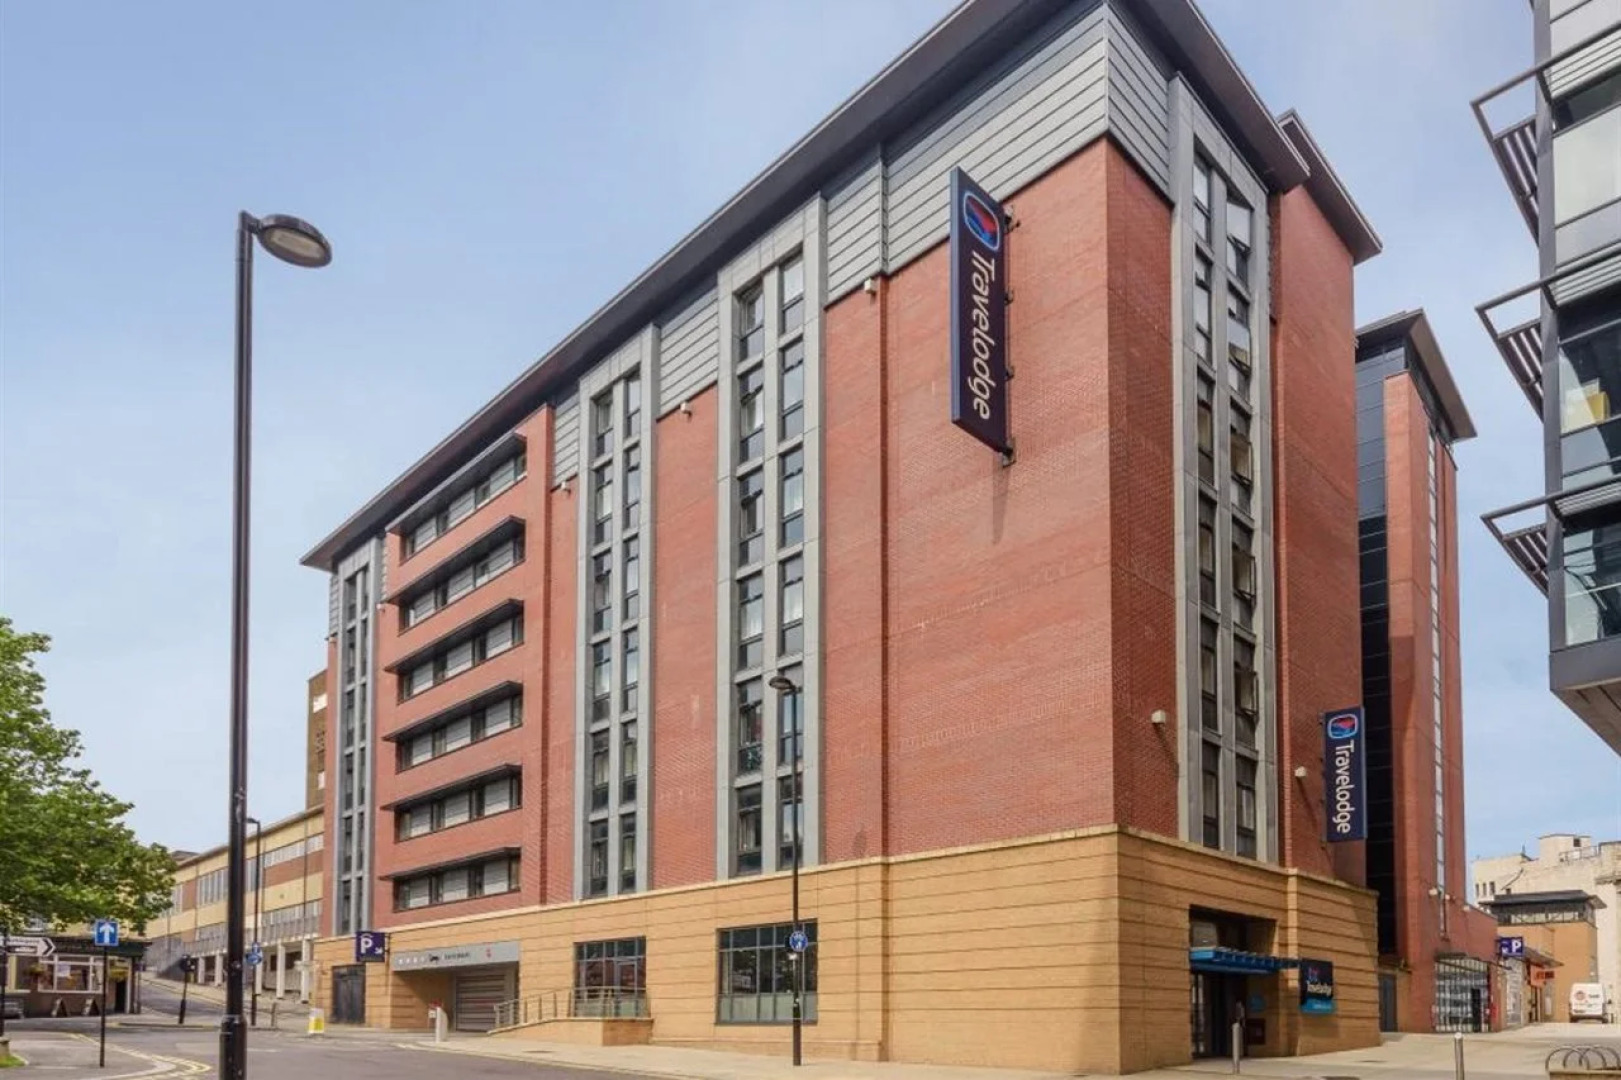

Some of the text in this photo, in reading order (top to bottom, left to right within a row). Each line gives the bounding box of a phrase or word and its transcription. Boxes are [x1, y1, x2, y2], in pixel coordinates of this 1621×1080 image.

[968, 250, 996, 420] Travelodge
[1332, 739, 1355, 834] Travelodge
[360, 937, 373, 954] P
[1511, 940, 1522, 953] P
